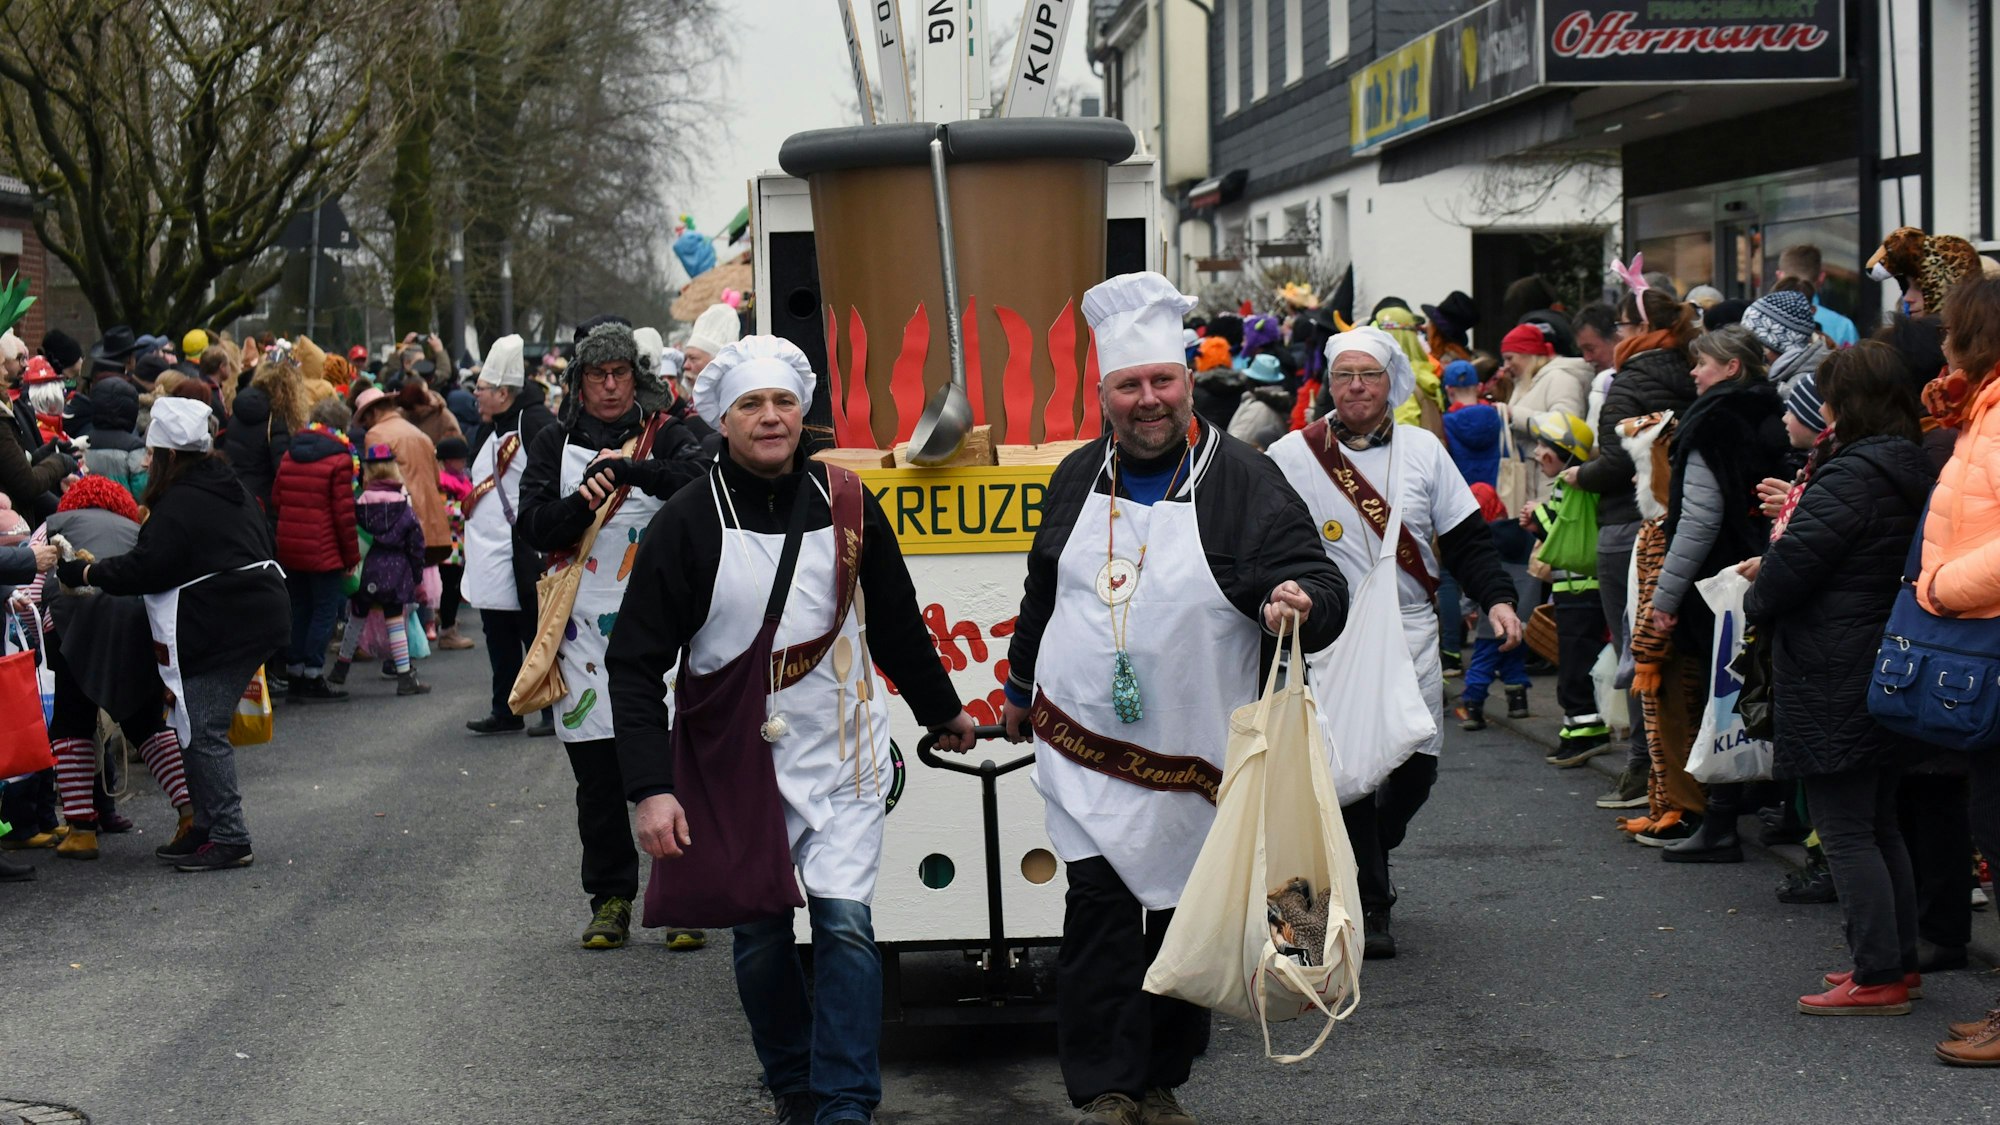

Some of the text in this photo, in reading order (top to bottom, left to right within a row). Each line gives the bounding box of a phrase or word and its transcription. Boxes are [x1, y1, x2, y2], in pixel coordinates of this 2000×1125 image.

[1023, 0, 1064, 86] KUP
[1551, 10, 1829, 59] Offermann
[874, 483, 1049, 535] REUZB
[1050, 722, 1106, 764] Jahre
[1117, 751, 1219, 801] Kreuzberg
